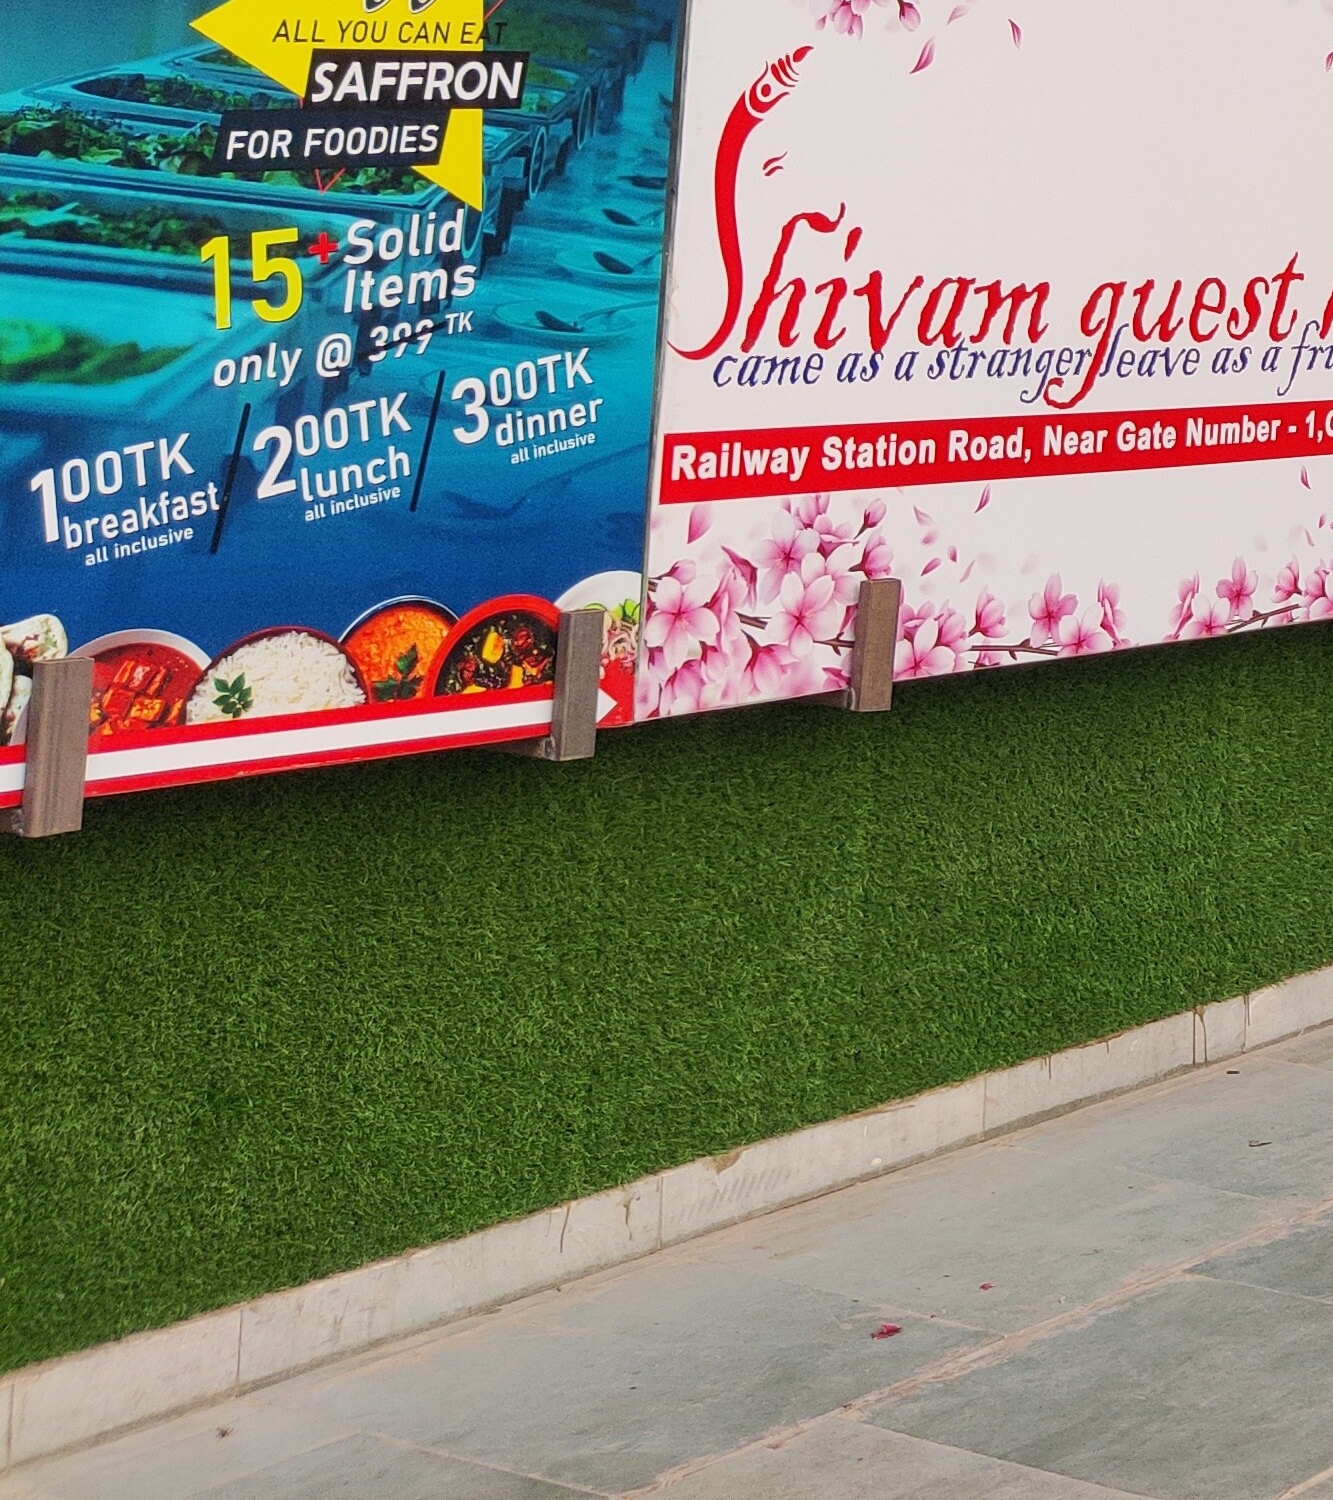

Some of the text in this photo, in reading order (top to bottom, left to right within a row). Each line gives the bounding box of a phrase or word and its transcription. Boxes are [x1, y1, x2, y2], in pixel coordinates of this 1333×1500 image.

[271, 19, 509, 45] ALL YOU CAN EAT
[311, 60, 524, 103] SAFFRON
[225, 124, 441, 160] FOR FOODIES
[343, 208, 466, 265] Solid
[666, 45, 1051, 360] Shivam
[1042, 251, 1305, 410] guest
[343, 265, 478, 314] Items
[213, 342, 303, 388] only
[316, 333, 353, 378] @
[444, 311, 474, 335] TK
[712, 351, 824, 388] came
[836, 350, 884, 383] as
[893, 350, 920, 381] a
[1098, 323, 1202, 378] leave
[1211, 346, 1253, 374] as
[1260, 346, 1281, 373] a
[451, 347, 594, 446] 300TK
[495, 398, 604, 447] dinner
[253, 392, 413, 501] 200TK
[300, 446, 411, 502] lunch
[511, 432, 597, 465] all inclusive
[671, 443, 811, 483] Railway
[820, 432, 937, 471] Station
[947, 425, 1032, 465] Road,
[1042, 423, 1108, 457] Near
[1116, 419, 1177, 452] Gate
[1185, 414, 1282, 447] Number
[30, 432, 196, 542] 100TK
[63, 481, 220, 549] breakfast
[305, 486, 401, 522] all inclusive
[85, 525, 195, 567] all inclusive
